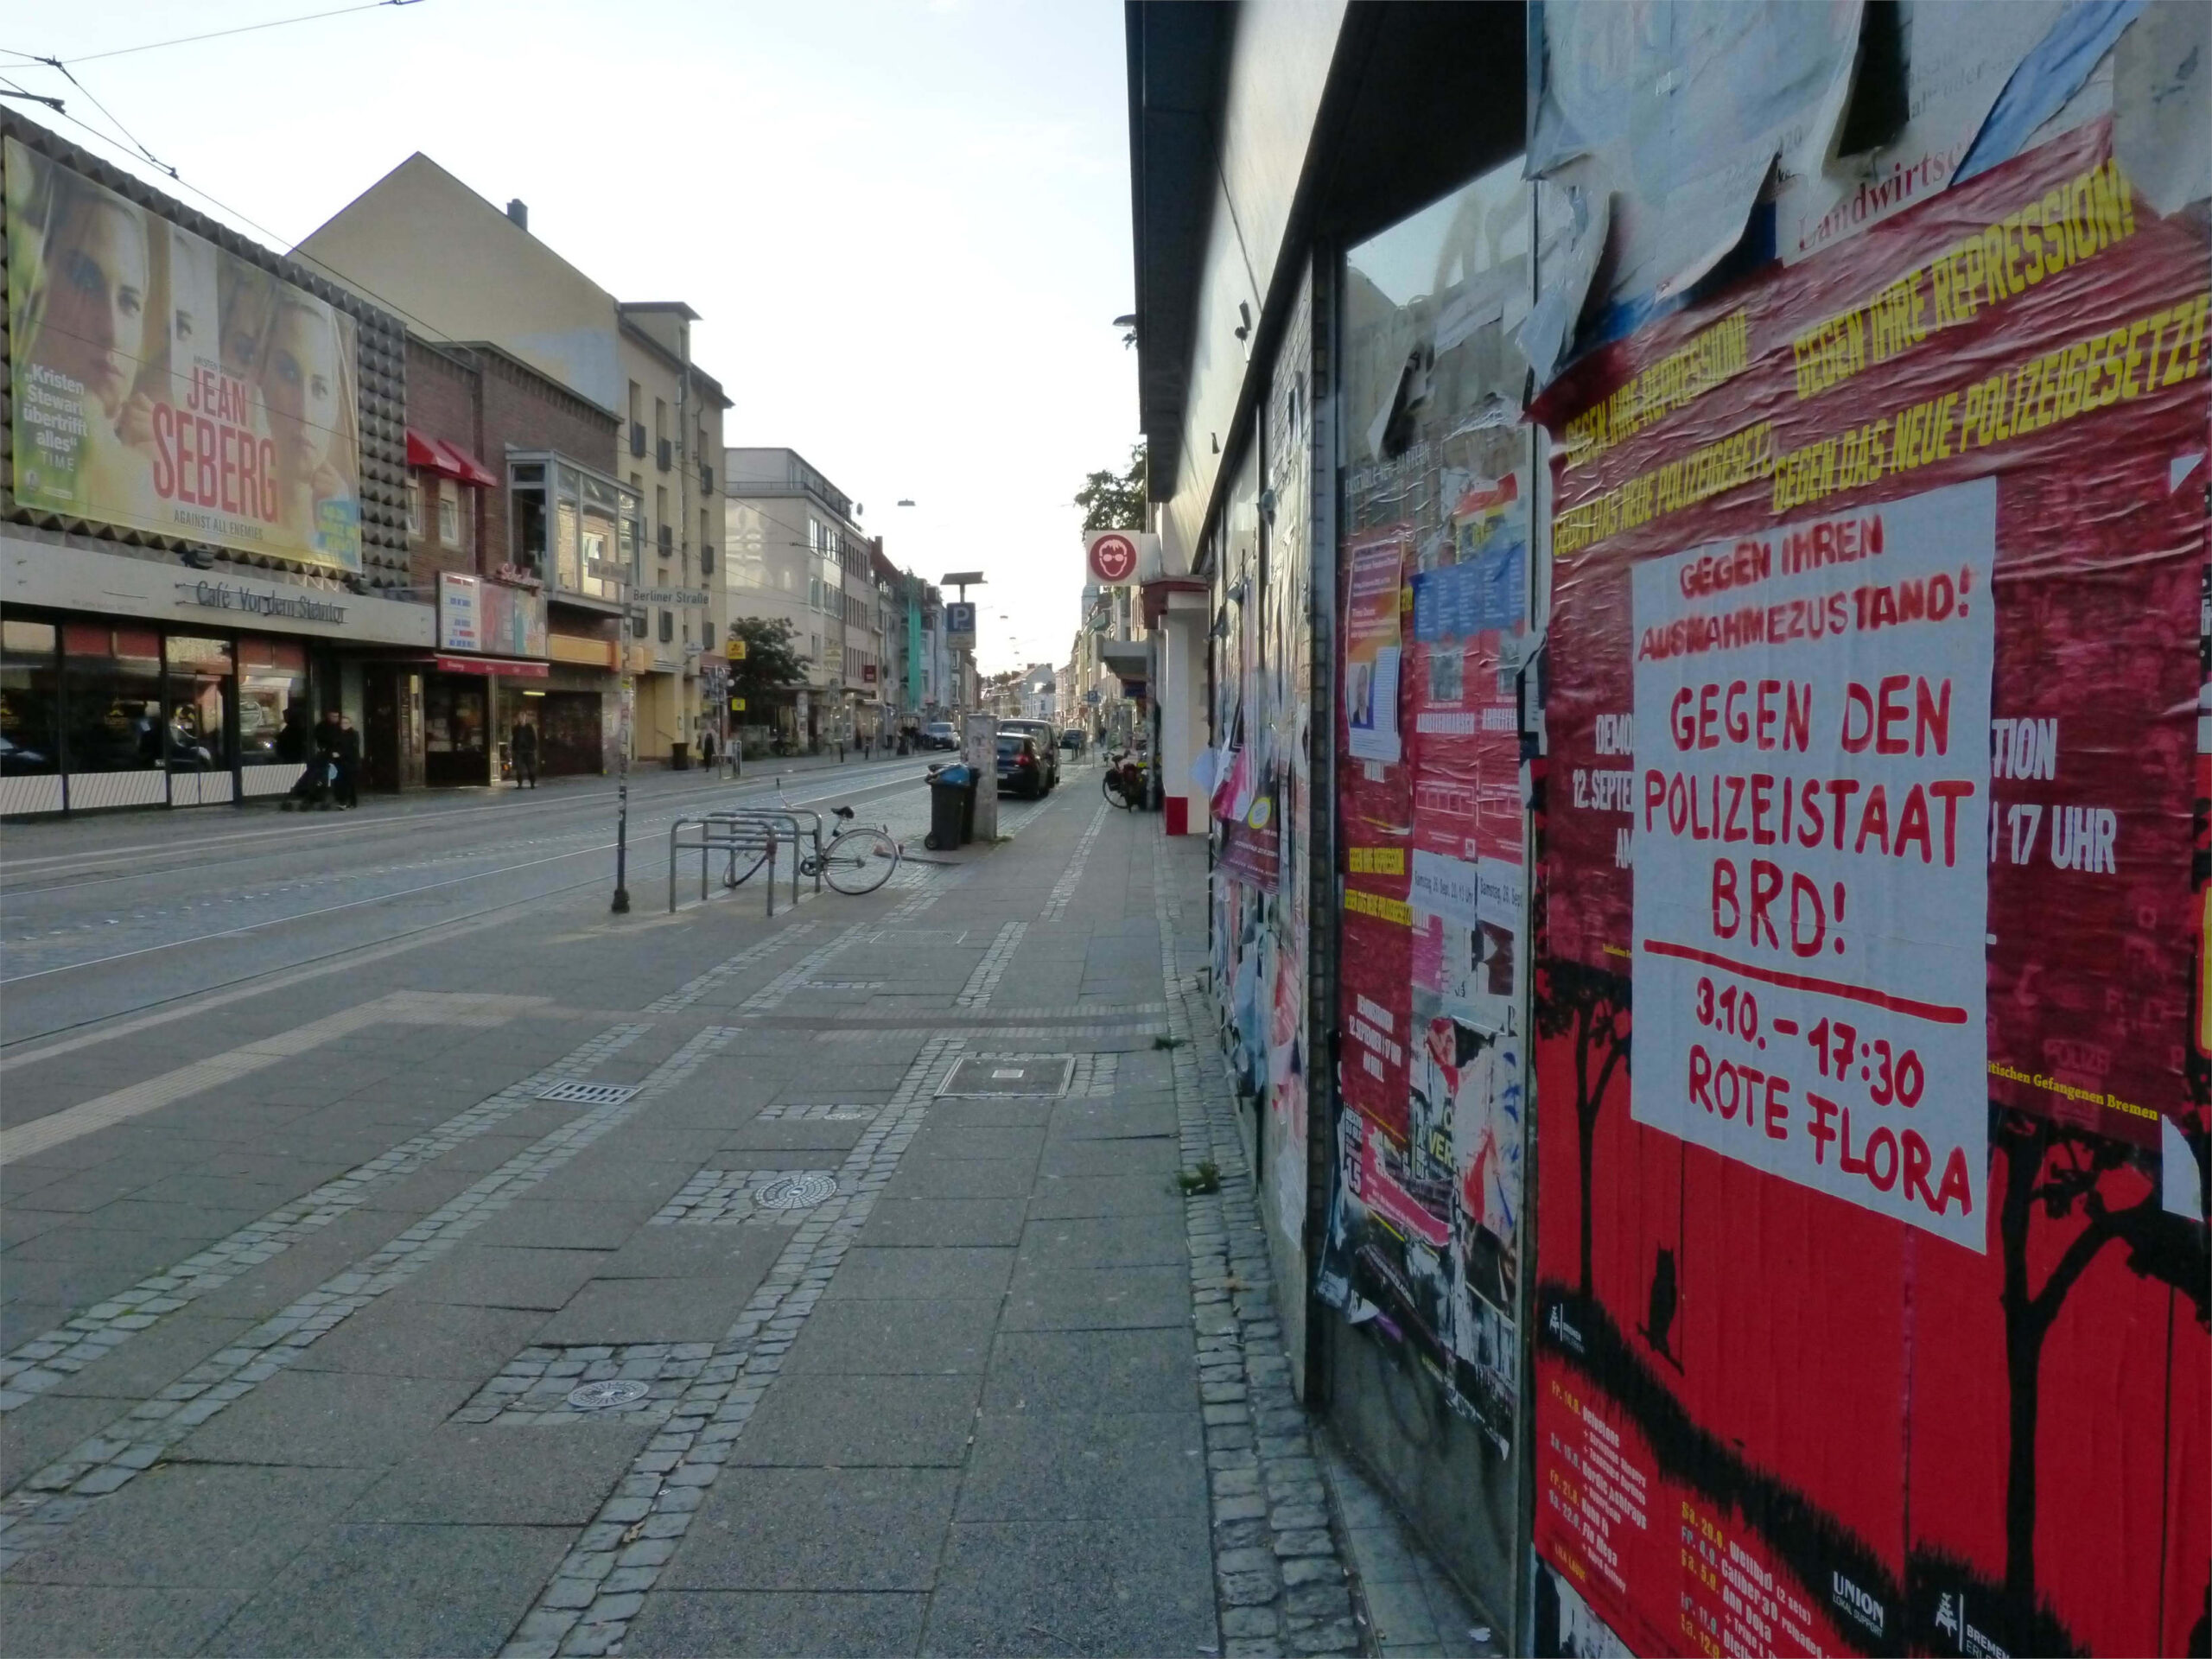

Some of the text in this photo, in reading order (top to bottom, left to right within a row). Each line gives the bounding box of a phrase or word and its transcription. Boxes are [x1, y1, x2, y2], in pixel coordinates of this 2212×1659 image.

[1793, 157, 2137, 400] GEGEN IHRE REPRESSION!
[23, 403, 87, 436] übertrifft
[28, 384, 84, 416] Stewart
[187, 365, 247, 426] JEAN
[1772, 295, 2209, 513] GEGEN DAS NEUE POLIZEIGESETZ!
[41, 450, 74, 472] TIME
[152, 402, 278, 524] SEBERG
[175, 509, 264, 541] AGAINST ALL ENEMIES
[1681, 514, 1883, 598] GEGEN IHREN
[196, 580, 345, 624] Café Vor dem Steintor
[633, 589, 709, 604] Berliner Straße
[953, 607, 969, 629] P
[1639, 565, 1976, 660] AUSNAHMEZUSTAND!
[1669, 673, 1951, 757] GEGEN DEN
[1644, 769, 1975, 868] POLIZEISTAAT
[2005, 804, 2042, 865] 17
[2051, 804, 2117, 875] UHR
[1711, 857, 1846, 957] BRD!
[2033, 1074, 2104, 1106] Gefangenen
[2107, 1094, 2158, 1121] Bremen
[1688, 1044, 1972, 1217] ROTE FLORA
[1833, 1570, 1885, 1628] UNION
[1833, 1594, 1883, 1638] LOKAL SUPPORT
[1967, 1624, 2011, 1659] BREMEN
